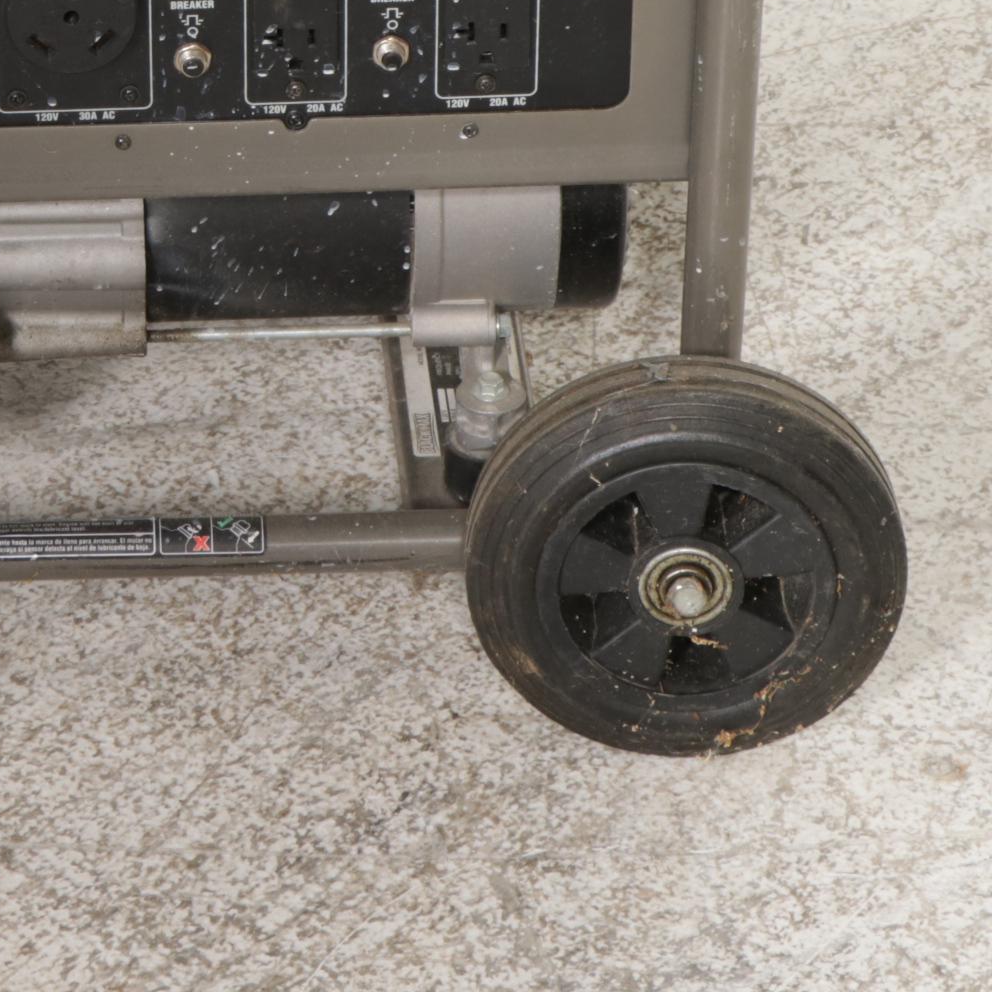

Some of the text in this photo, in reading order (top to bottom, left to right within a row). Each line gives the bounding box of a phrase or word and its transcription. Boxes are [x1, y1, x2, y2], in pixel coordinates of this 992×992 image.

[170, 0, 215, 10] BREAKER
[263, 102, 343, 114] 120V 20A AC
[446, 97, 527, 108] 120V 20A AC
[35, 110, 116, 121] 120V 30A AC
